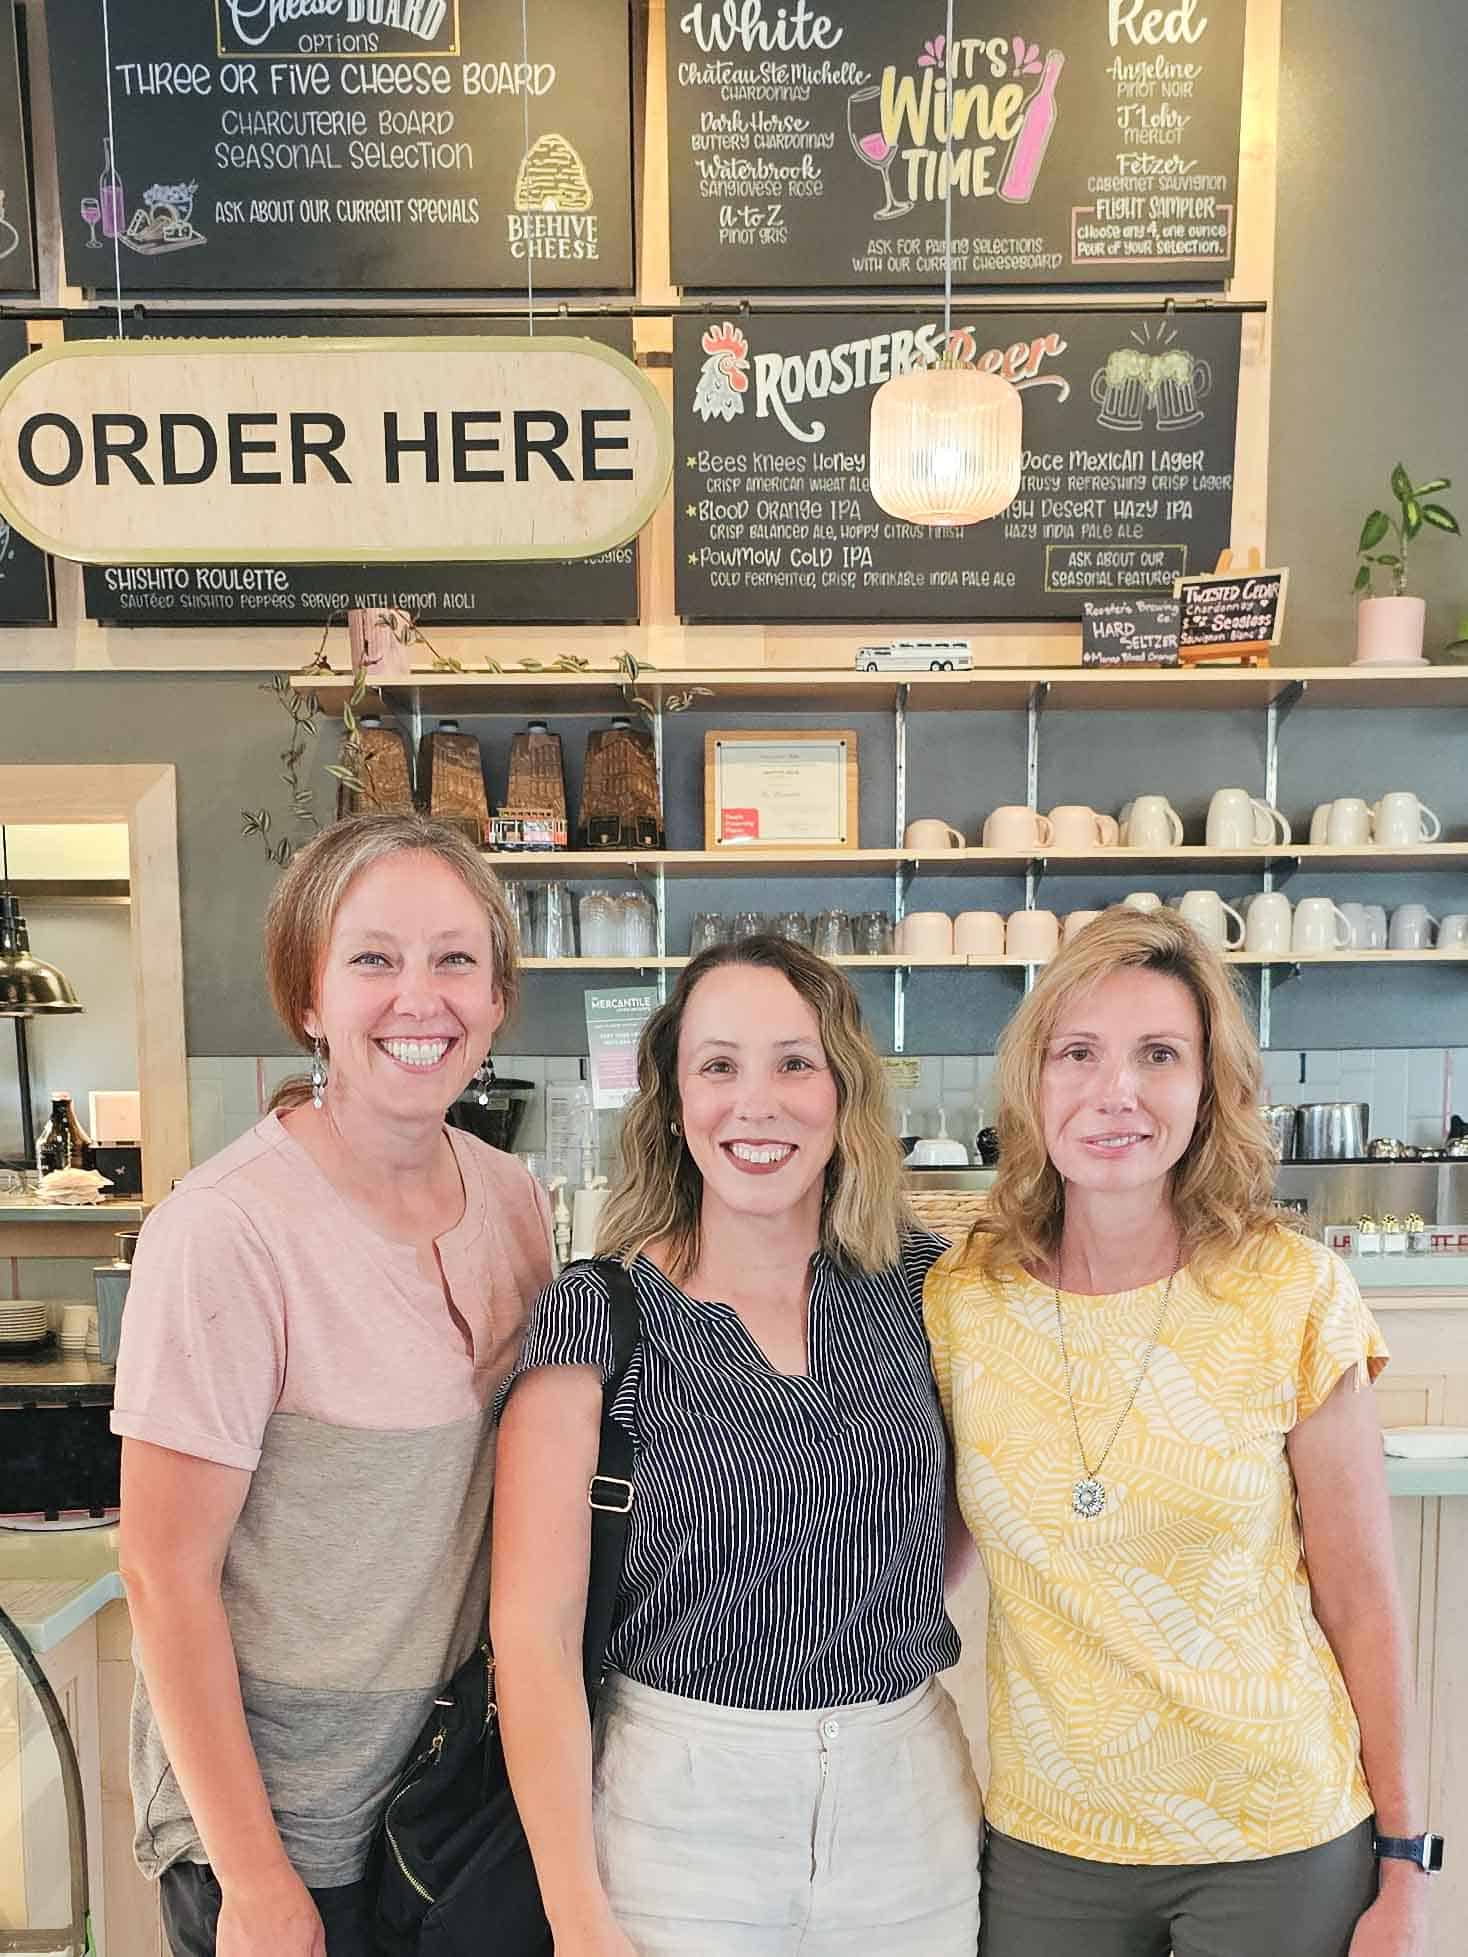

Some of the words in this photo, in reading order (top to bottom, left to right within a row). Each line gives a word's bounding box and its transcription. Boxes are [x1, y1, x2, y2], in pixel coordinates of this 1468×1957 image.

[680, 0, 843, 52] White
[1108, 0, 1208, 47] Red
[947, 37, 1009, 79] IT'S
[1106, 55, 1203, 83] Angeline
[220, 62, 258, 95] OR
[463, 61, 556, 96] BOARD
[791, 60, 871, 86] Michelle
[880, 65, 1025, 147] Wine
[379, 109, 454, 136] BOARD
[701, 109, 750, 133] Dark
[750, 110, 810, 133] Horse
[695, 154, 822, 180] Waterbrook
[901, 146, 997, 201] TIME
[1116, 152, 1199, 176] Fetzer
[215, 200, 245, 224] ASK
[250, 199, 296, 224] ABOUT
[300, 199, 331, 223] OUR
[766, 204, 784, 227] Z
[507, 215, 598, 243] BEEHIVE
[511, 238, 600, 260] CHEESE
[867, 238, 893, 256] ASK
[896, 238, 922, 256] FOR
[852, 256, 883, 272] WITH
[887, 256, 911, 272] OUR
[754, 324, 938, 443] ROOSTERS
[18, 413, 351, 486] ORDER
[384, 409, 634, 483] HERE
[706, 477, 741, 493] CRISP
[1151, 475, 1188, 491] CRISP
[831, 500, 862, 521] IPA
[1166, 501, 1193, 520] IPA
[709, 525, 744, 541] CRISP
[883, 524, 925, 540] CITRUS
[842, 546, 873, 569] IPA
[1068, 552, 1093, 568] ASK
[1096, 551, 1137, 568] ABOUT
[1140, 551, 1165, 567] OUR
[104, 567, 190, 591] SHISHITO
[710, 571, 741, 588] COLD
[180, 593, 234, 609] SHISHITO
[354, 592, 388, 610] WITH
[442, 592, 476, 609] AIOLI
[1092, 621, 1136, 639] HARD
[1119, 634, 1178, 650] SELTZER
[591, 996, 651, 1009] MERCANTILE
